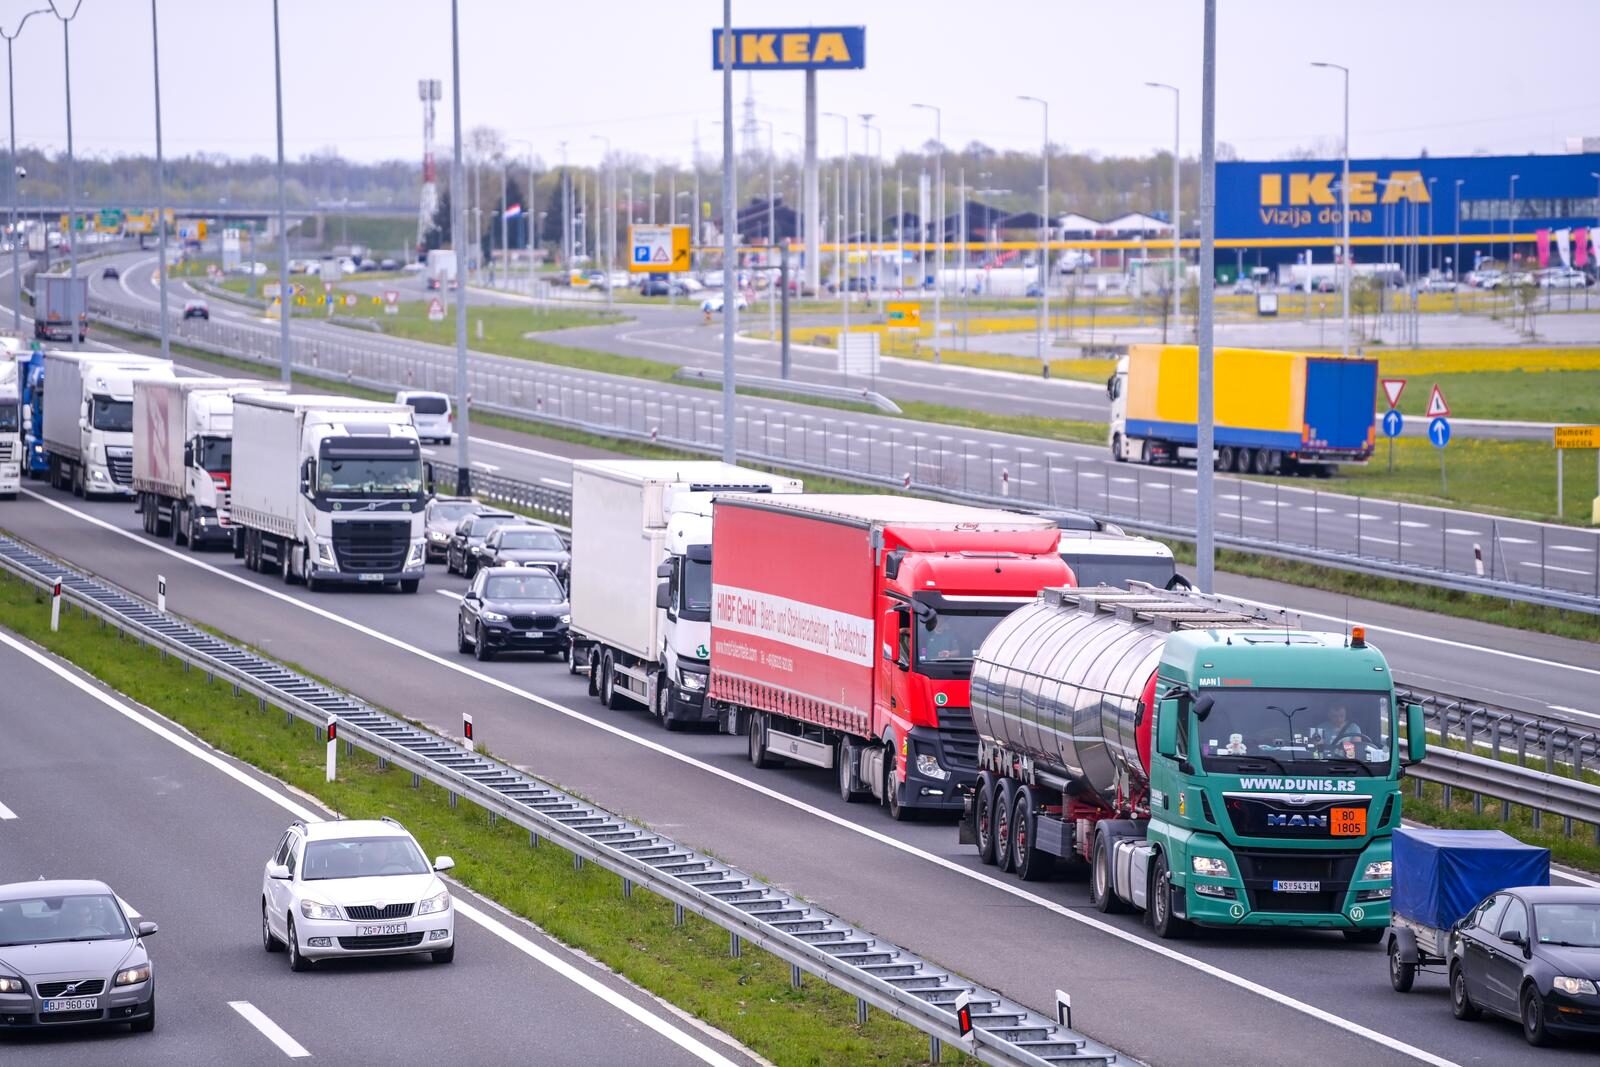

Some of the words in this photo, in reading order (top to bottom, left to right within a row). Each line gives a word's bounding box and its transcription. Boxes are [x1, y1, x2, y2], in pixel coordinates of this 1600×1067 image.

[719, 33, 851, 63] IKEA
[1260, 171, 1431, 205] IKEA
[1259, 209, 1312, 227] Vizija
[1318, 208, 1372, 223] doma
[717, 592, 736, 621] HMBF
[737, 596, 757, 627] GmbH
[1199, 678, 1217, 686] MAN
[1240, 778, 1356, 792] WWW.DUNIS.RS
[1267, 813, 1327, 827] MAN
[1342, 811, 1355, 820] 80
[1337, 823, 1361, 833] 1805
[1278, 882, 1288, 890] NS
[363, 926, 373, 935] ZG
[49, 1002, 60, 1011] BJ
